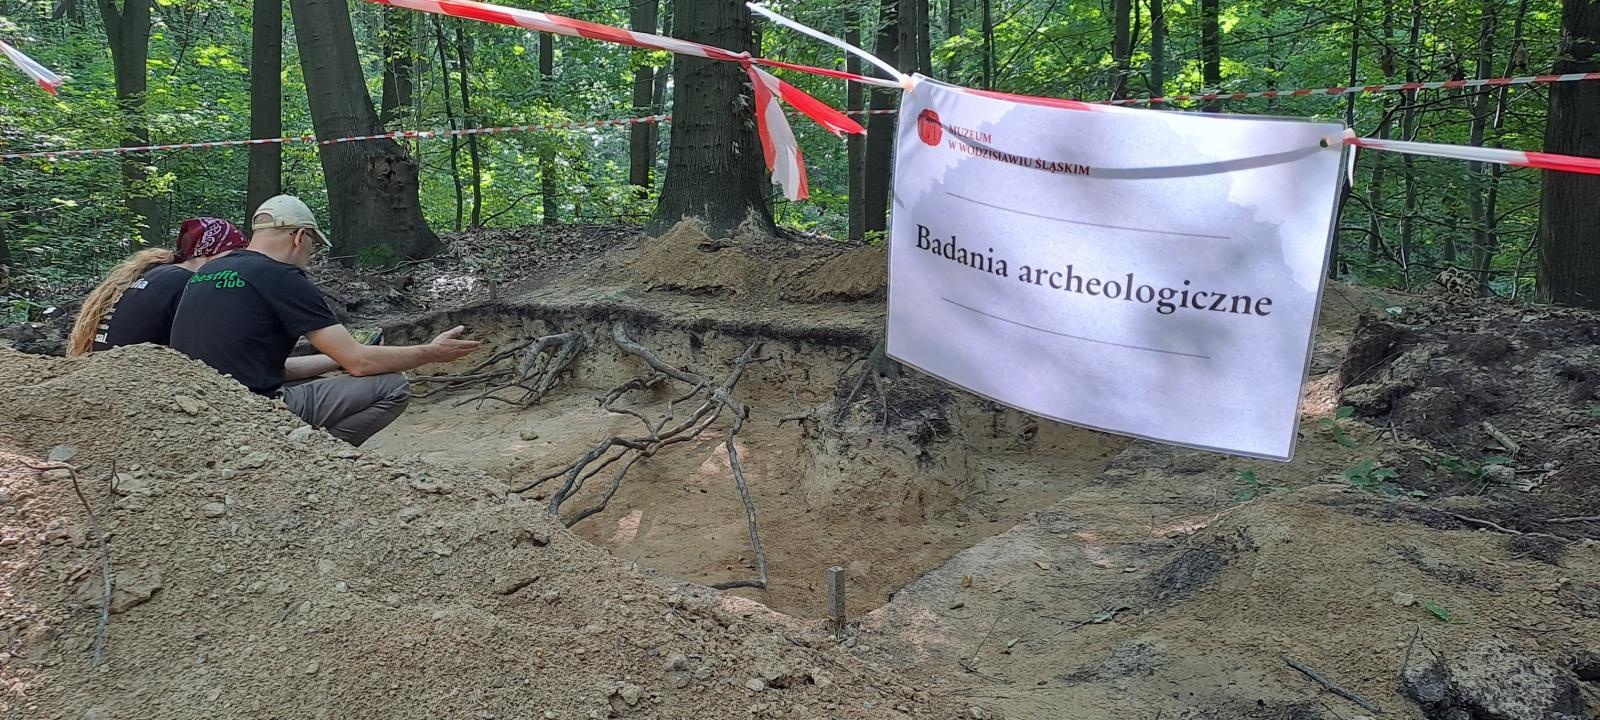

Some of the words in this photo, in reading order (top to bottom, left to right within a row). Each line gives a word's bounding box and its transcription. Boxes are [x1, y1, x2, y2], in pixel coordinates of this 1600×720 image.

[948, 124, 993, 144] MUZEUM
[948, 139, 957, 149] W
[1034, 157, 1091, 176] ŚLĄSKIM
[215, 278, 246, 289] club
[915, 223, 1009, 278] Badania
[1018, 264, 1273, 317] archeologiczne
